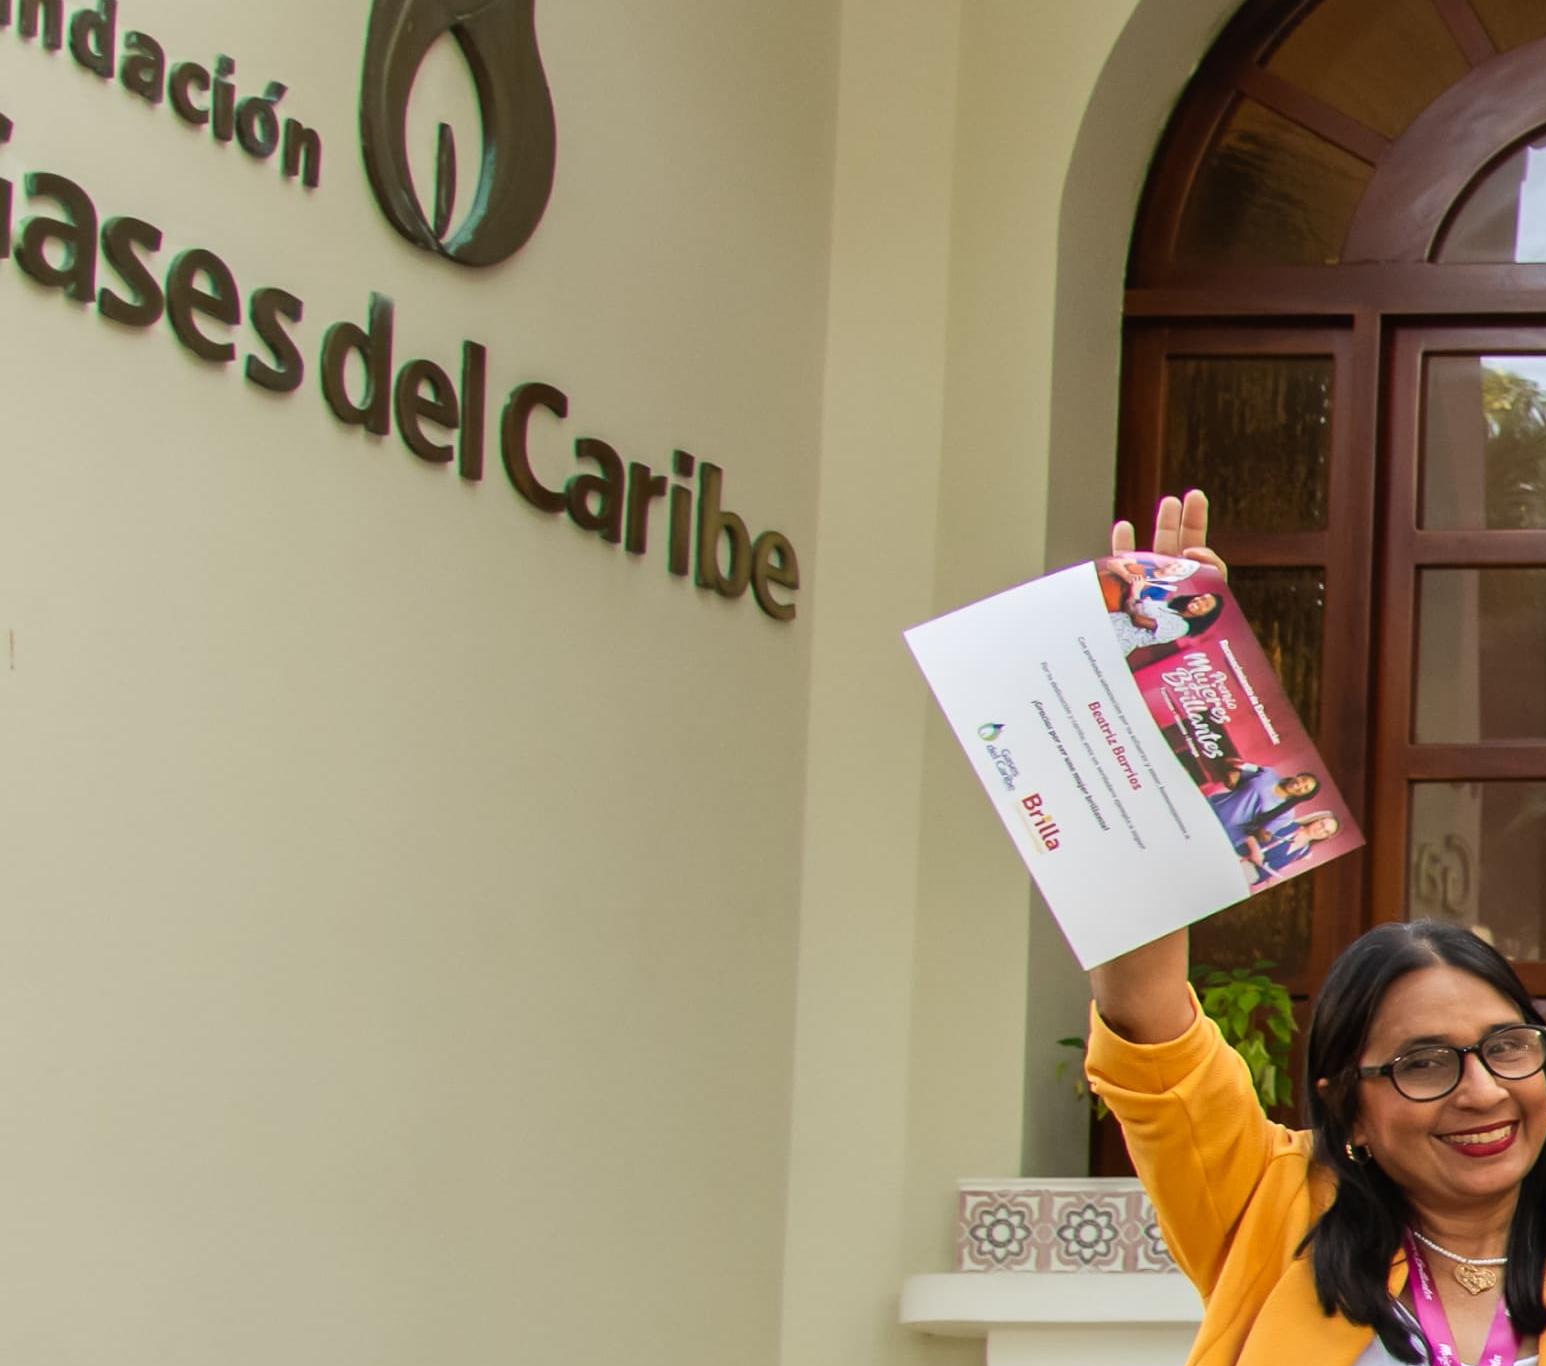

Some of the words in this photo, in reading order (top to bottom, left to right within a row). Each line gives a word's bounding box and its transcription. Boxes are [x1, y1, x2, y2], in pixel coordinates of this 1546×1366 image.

[0, 0, 321, 188] ndación
[0, 113, 304, 392] ases
[321, 292, 487, 481] del
[501, 382, 801, 621] Caribe
[1162, 668, 1223, 760] Brillantes
[1184, 652, 1230, 724] Mujeres
[1210, 670, 1237, 710] Premio
[1000, 748, 1020, 778] Gases
[1088, 700, 1117, 746] Beatriz
[1112, 746, 1142, 791] Barrios
[1021, 792, 1060, 852] Brilla
